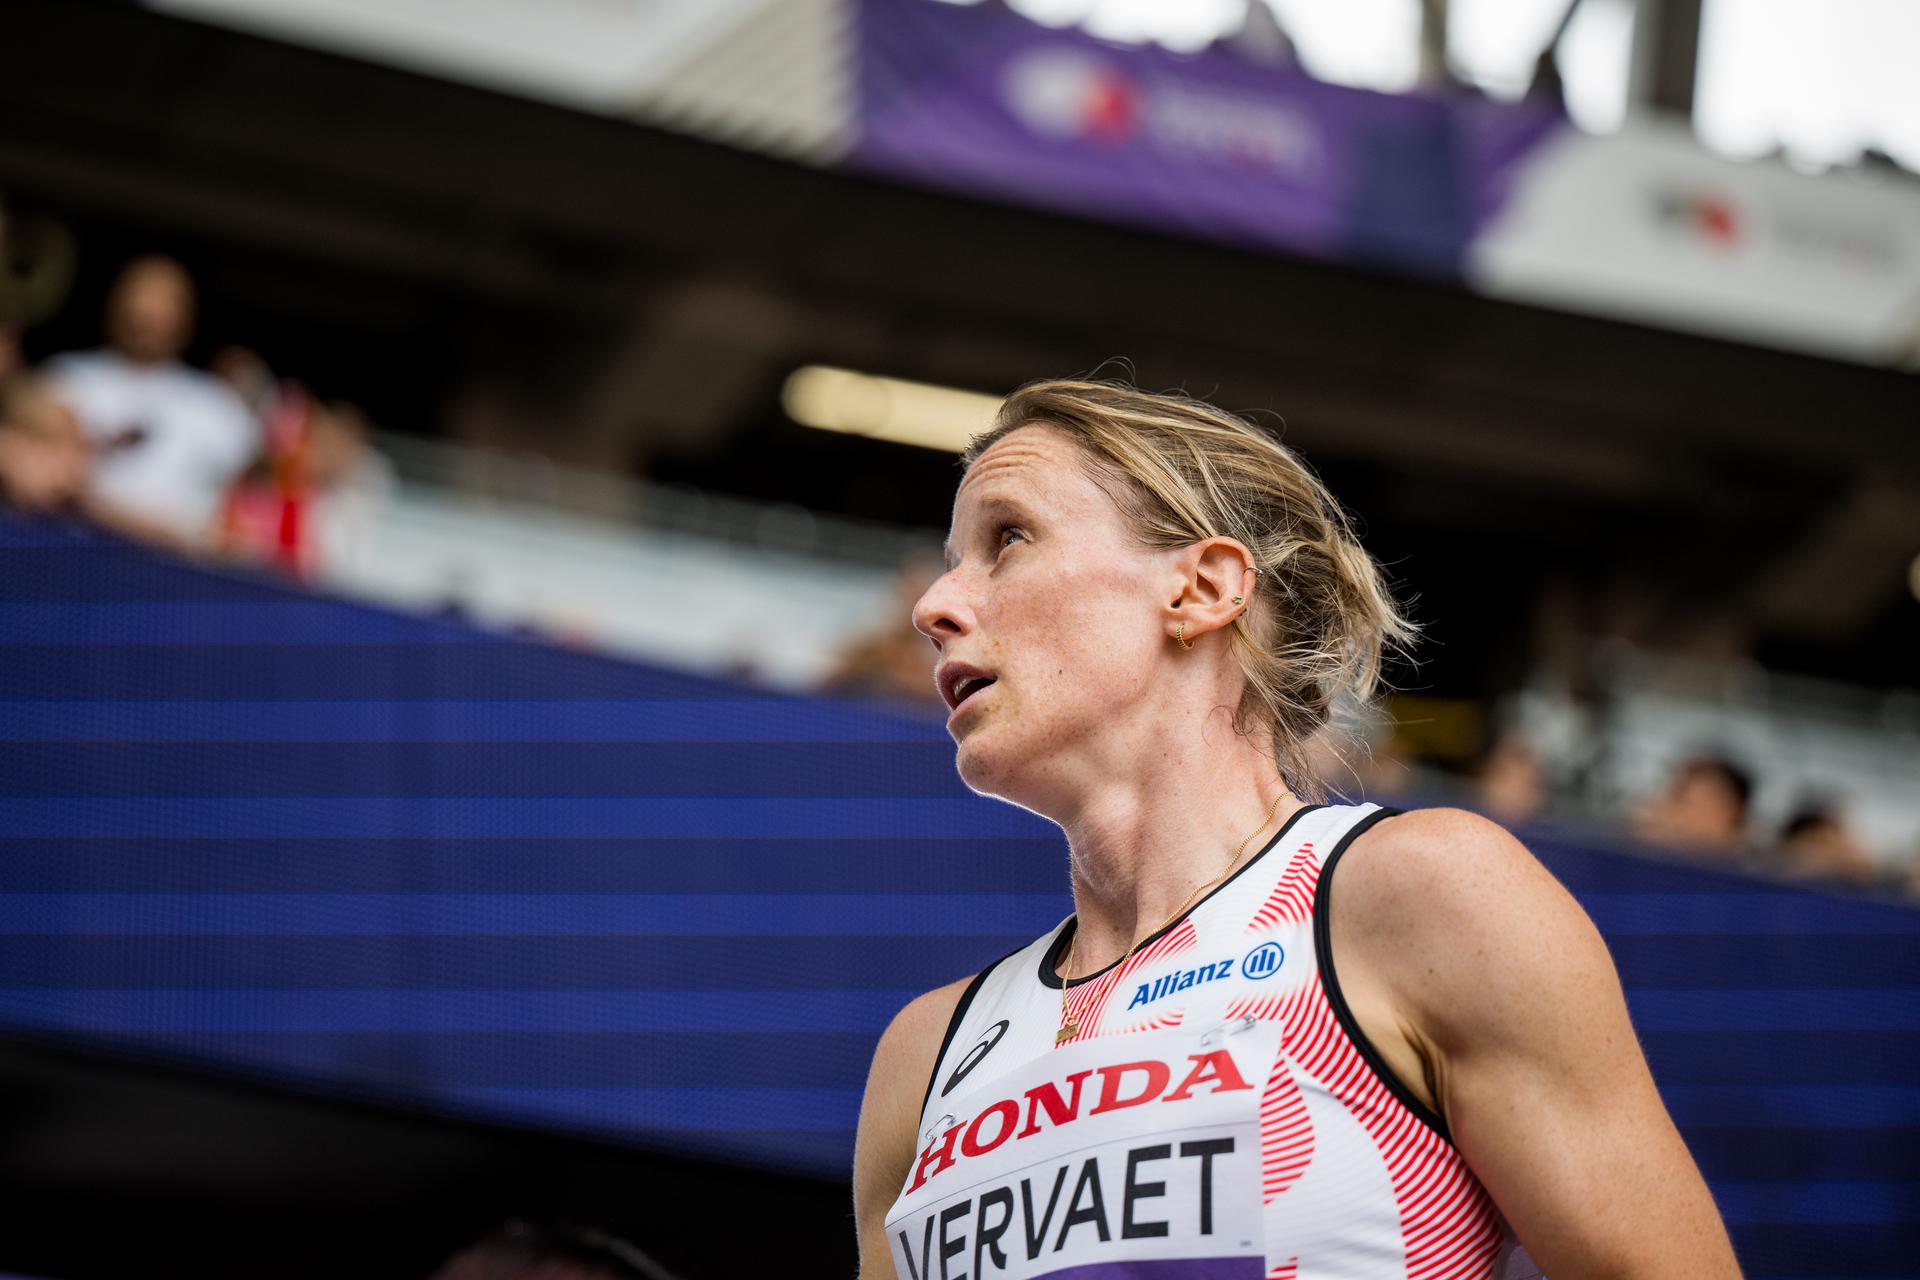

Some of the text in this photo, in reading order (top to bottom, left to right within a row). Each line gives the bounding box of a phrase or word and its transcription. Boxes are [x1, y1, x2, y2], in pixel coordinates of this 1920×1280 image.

[1127, 959, 1235, 1011] Allianz
[905, 1048, 1255, 1197] HONDA
[898, 1137, 1236, 1280] VERVAET
